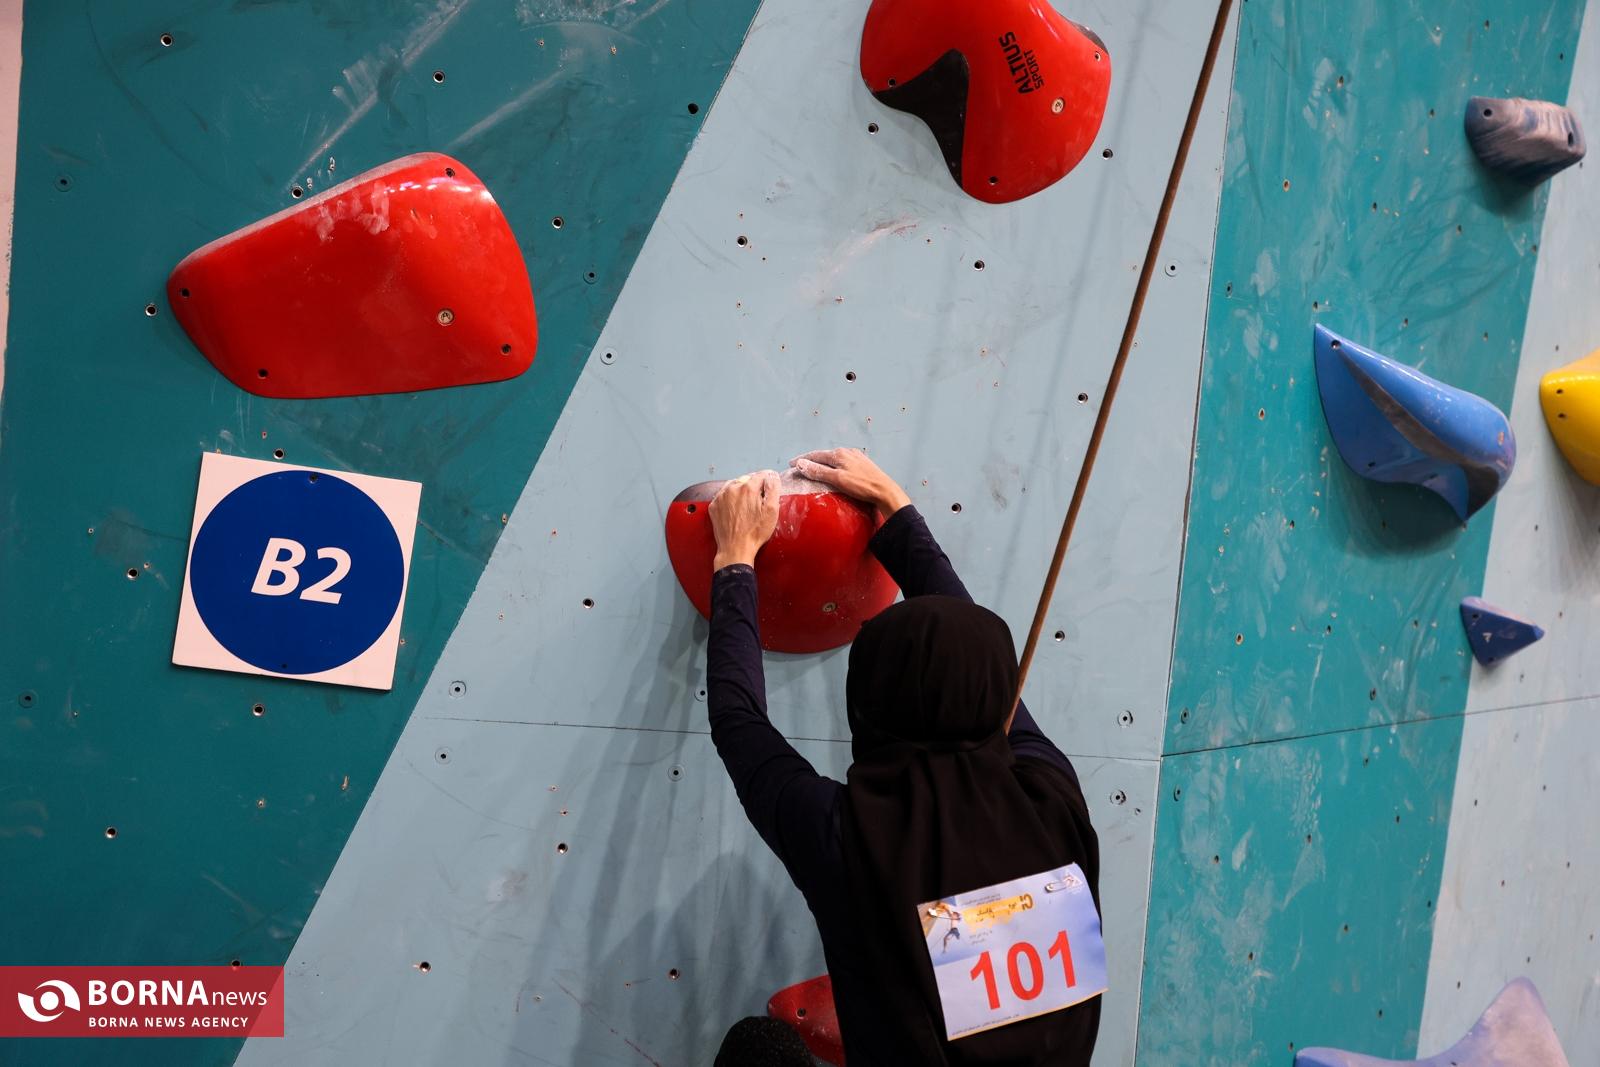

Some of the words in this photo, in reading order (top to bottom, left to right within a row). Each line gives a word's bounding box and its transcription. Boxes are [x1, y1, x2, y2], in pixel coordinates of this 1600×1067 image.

[998, 31, 1034, 93] ALTIUS
[1023, 49, 1044, 89] SPORT
[250, 537, 352, 605] B2
[970, 930, 1076, 1011] 101
